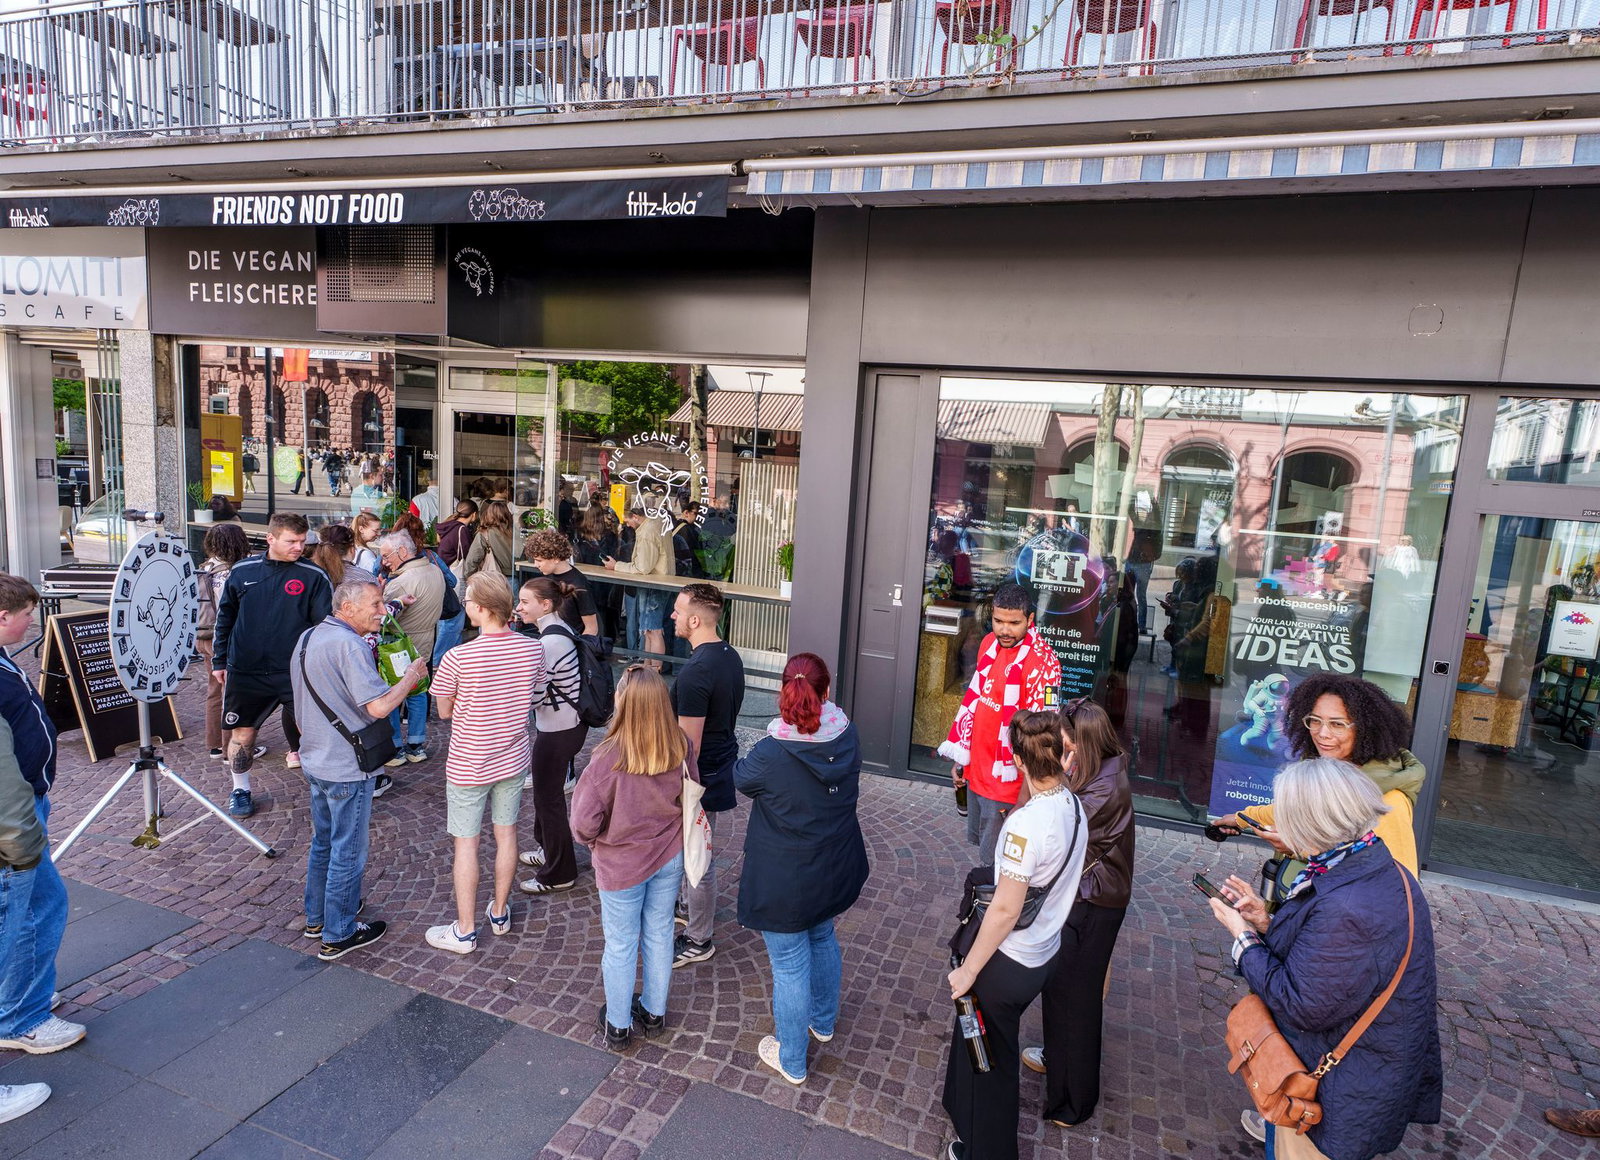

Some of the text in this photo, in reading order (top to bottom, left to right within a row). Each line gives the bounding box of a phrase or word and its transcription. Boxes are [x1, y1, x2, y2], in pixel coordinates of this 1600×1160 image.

[212, 193, 404, 225] FRIENDS NOT FOOD
[188, 251, 316, 271] DIE VEGAN
[607, 431, 710, 529] DIE VEGANE FLEISCHEREI
[179, 578, 188, 599] DIE
[1033, 583, 1081, 594] EXPEDITION
[1253, 596, 1349, 614] robotspaceship
[172, 603, 189, 656] VEGANE
[1057, 627, 1066, 636] in
[1067, 629, 1082, 638] die
[1245, 623, 1352, 646] INNOVATIVE
[1250, 616, 1350, 633] YOUR LAUNCHPAD FOR
[1055, 639, 1070, 648] mit
[1071, 642, 1100, 652] einem
[1236, 634, 1356, 675] IDEAS
[130, 645, 174, 675] FLEISCHEREI
[1081, 653, 1096, 663] ist!
[1227, 779, 1248, 788] Jetzt
